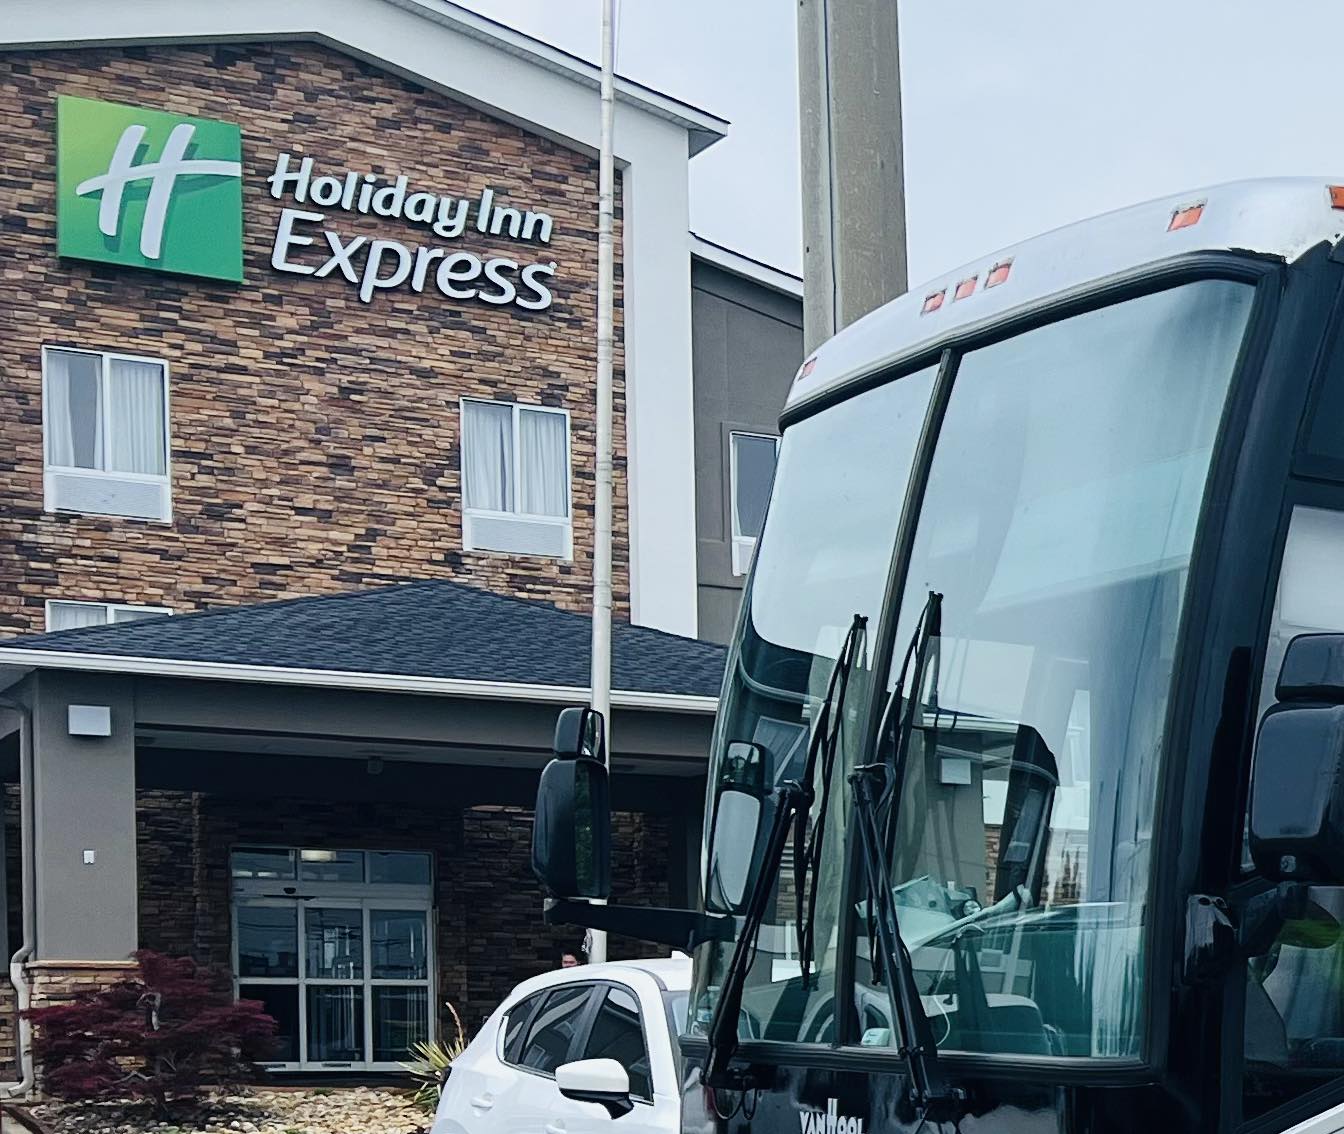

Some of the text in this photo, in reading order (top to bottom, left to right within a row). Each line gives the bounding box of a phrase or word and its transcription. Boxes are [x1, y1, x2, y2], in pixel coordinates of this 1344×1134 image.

[266, 153, 554, 244] Holiday Inn
[271, 208, 556, 311] Express
